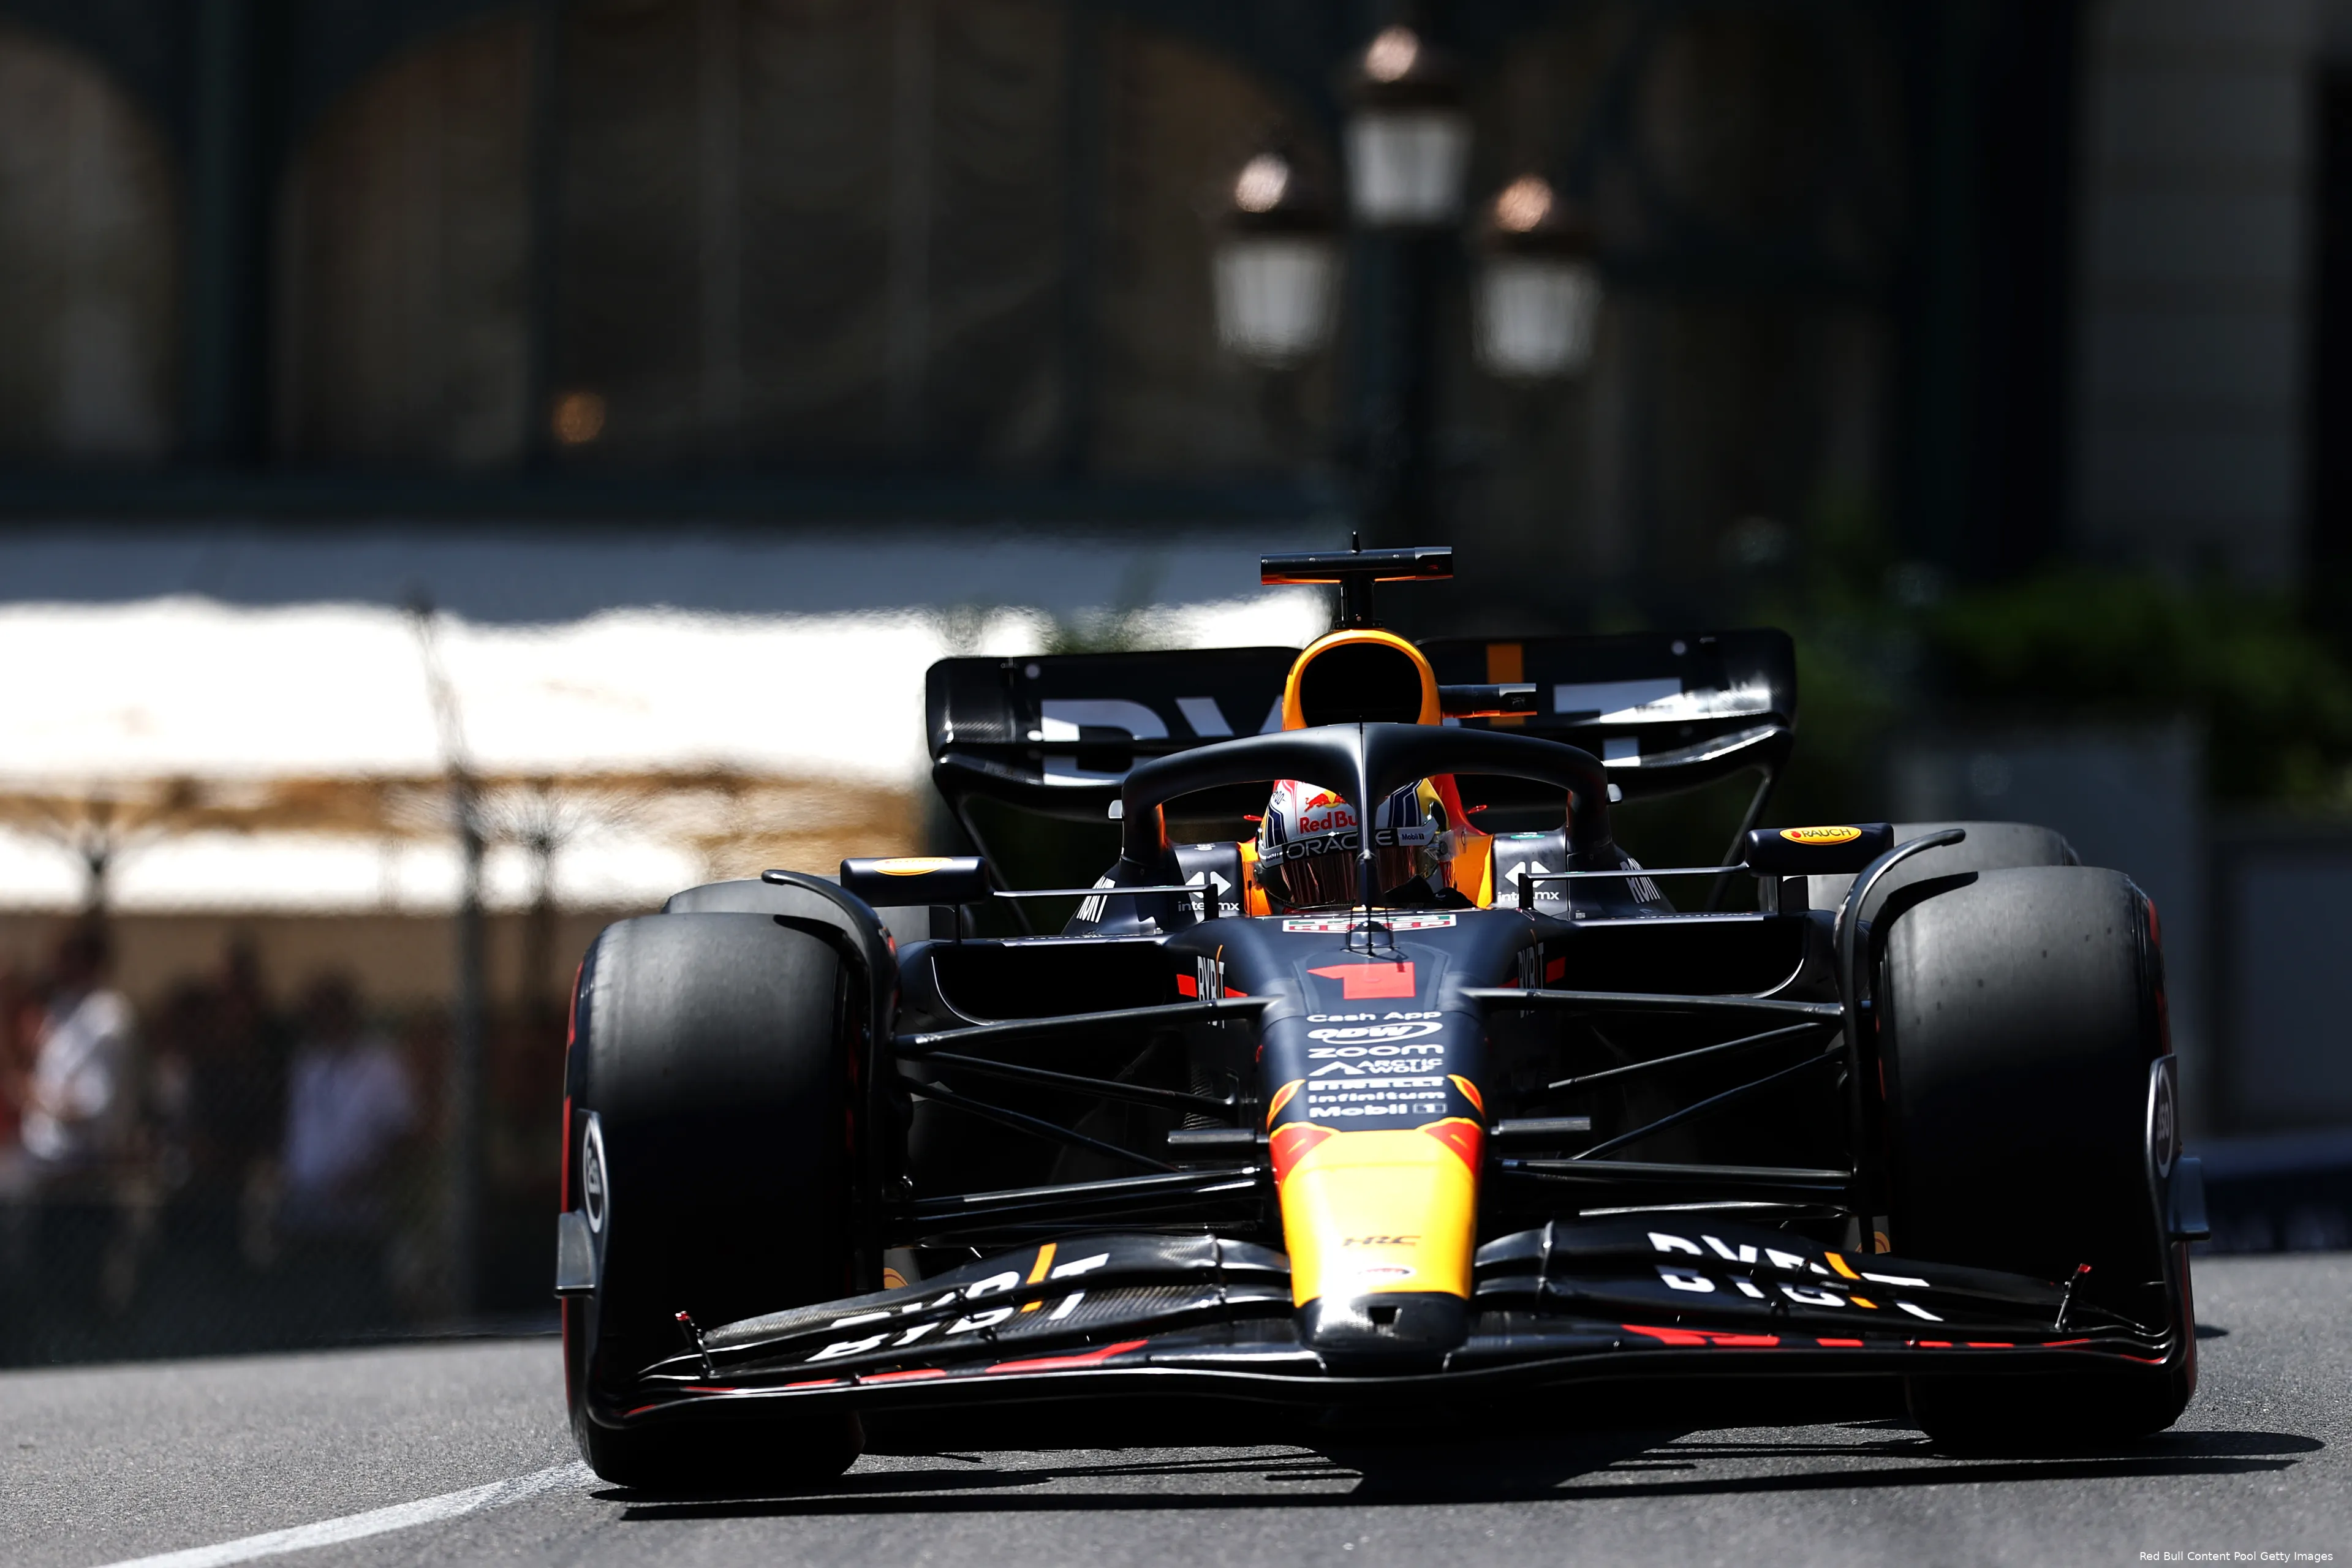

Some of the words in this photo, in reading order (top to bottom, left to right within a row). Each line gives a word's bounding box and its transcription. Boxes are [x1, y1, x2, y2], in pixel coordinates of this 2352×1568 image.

[1299, 812, 1332, 834] Red
[1335, 810, 1358, 828] Bu
[1802, 828, 1851, 837] RAUCH
[1287, 829, 1394, 859] ORACE
[1307, 962, 1416, 1000] 1
[1306, 1012, 1376, 1022] Cash
[1383, 1011, 1442, 1020] App
[1356, 1058, 1443, 1068] ARCTIC
[1368, 1065, 1436, 1074] WOLF
[1309, 1103, 1408, 1118] Mobil
